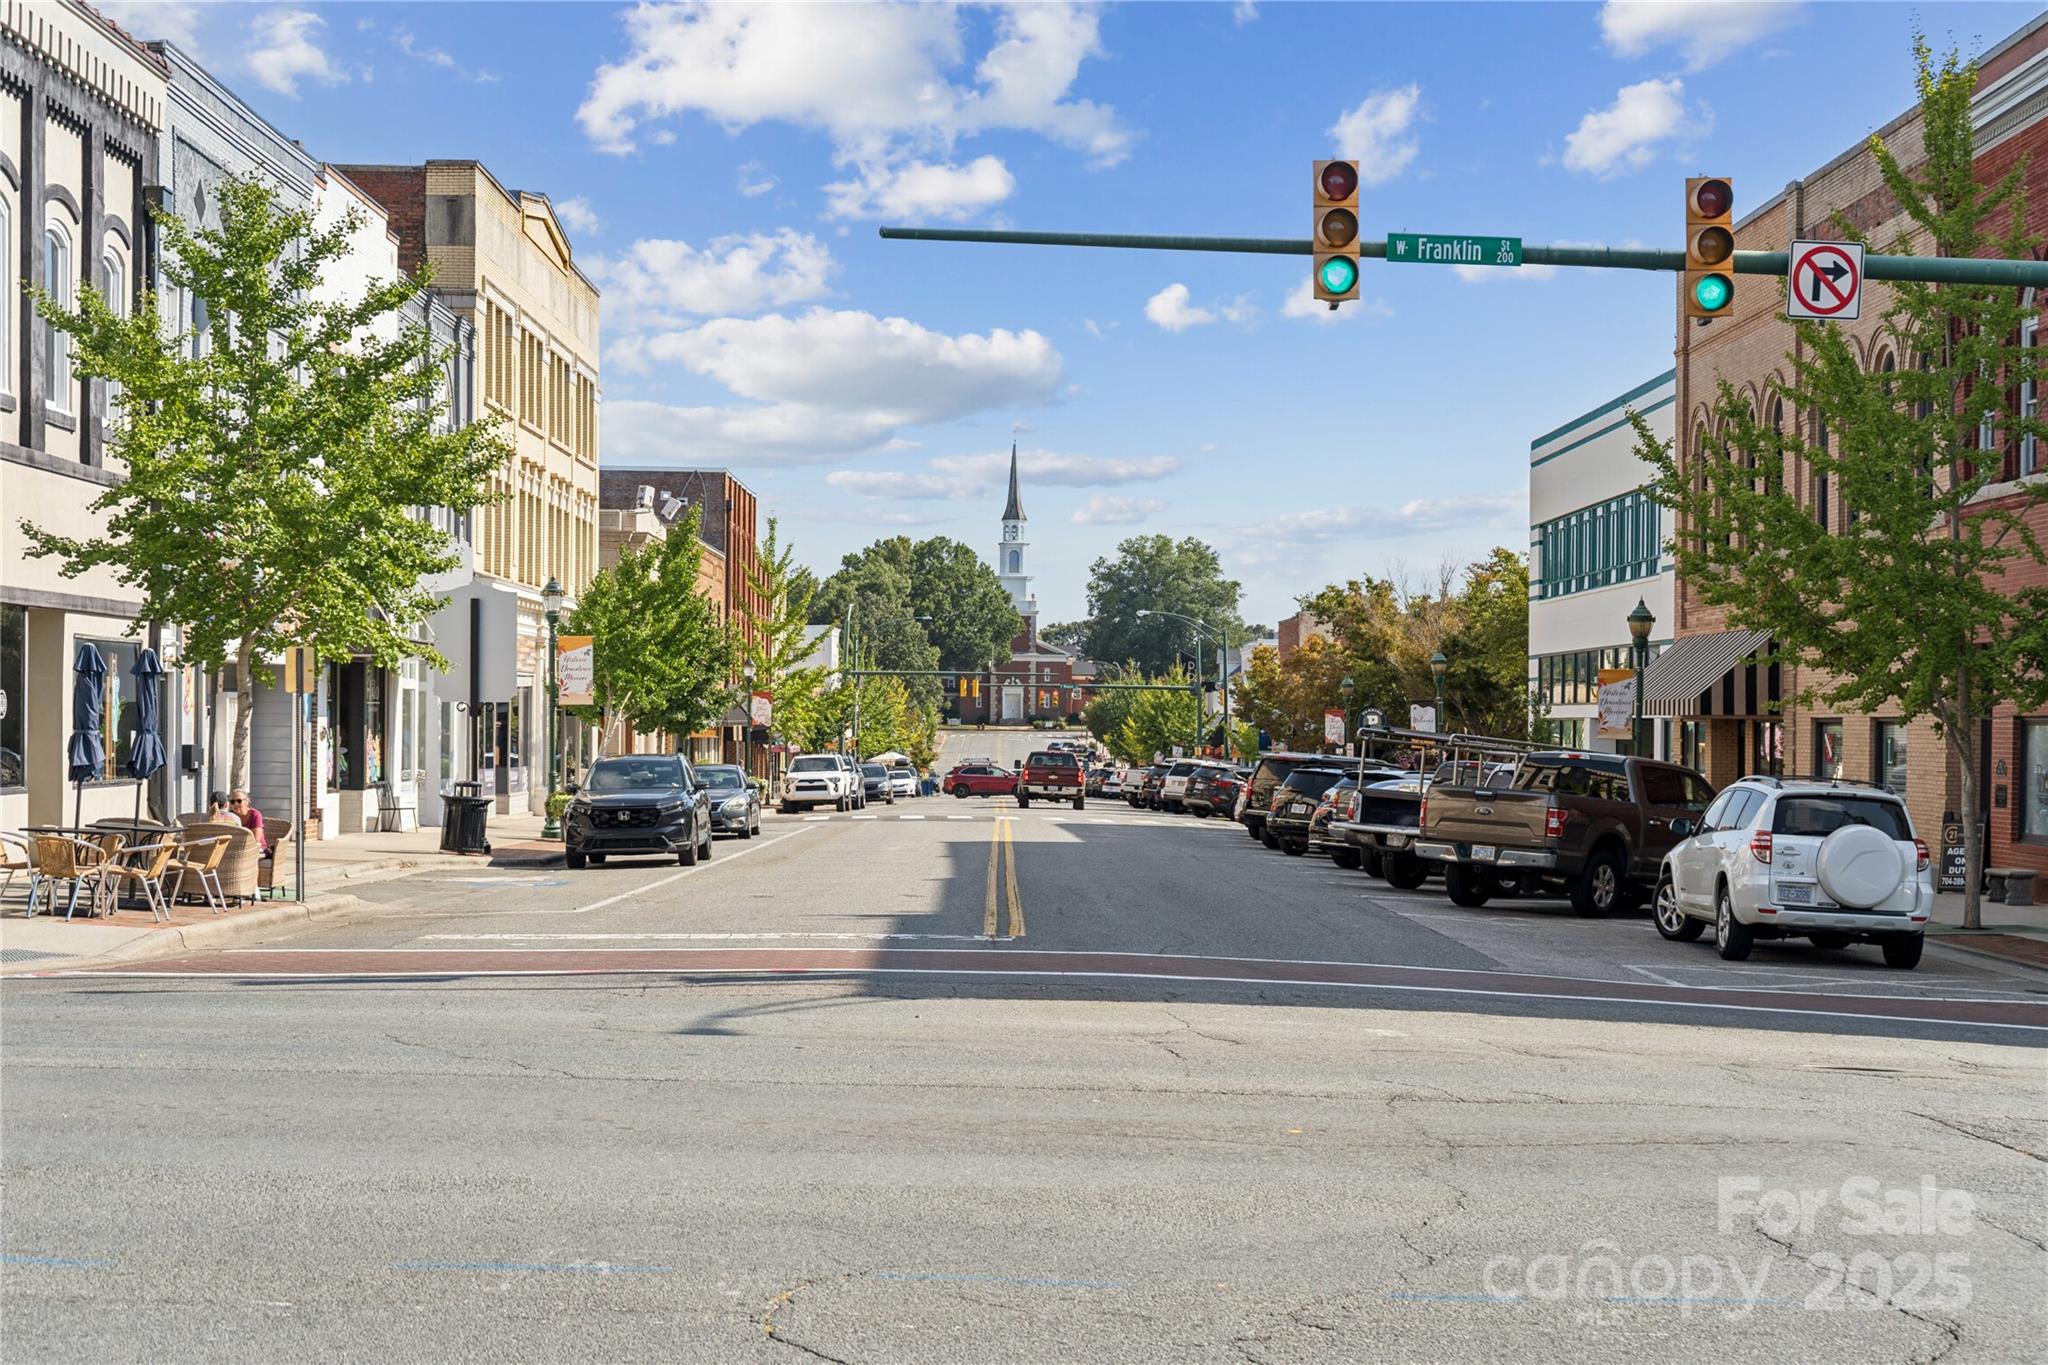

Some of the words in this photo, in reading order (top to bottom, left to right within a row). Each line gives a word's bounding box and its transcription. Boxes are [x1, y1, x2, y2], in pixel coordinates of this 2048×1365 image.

[1418, 237, 1482, 261] Franklin
[1501, 239, 1511, 252] St
[1496, 251, 1514, 263] 200
[1947, 847, 1966, 856] AGE
[1948, 866, 1967, 874] DUT
